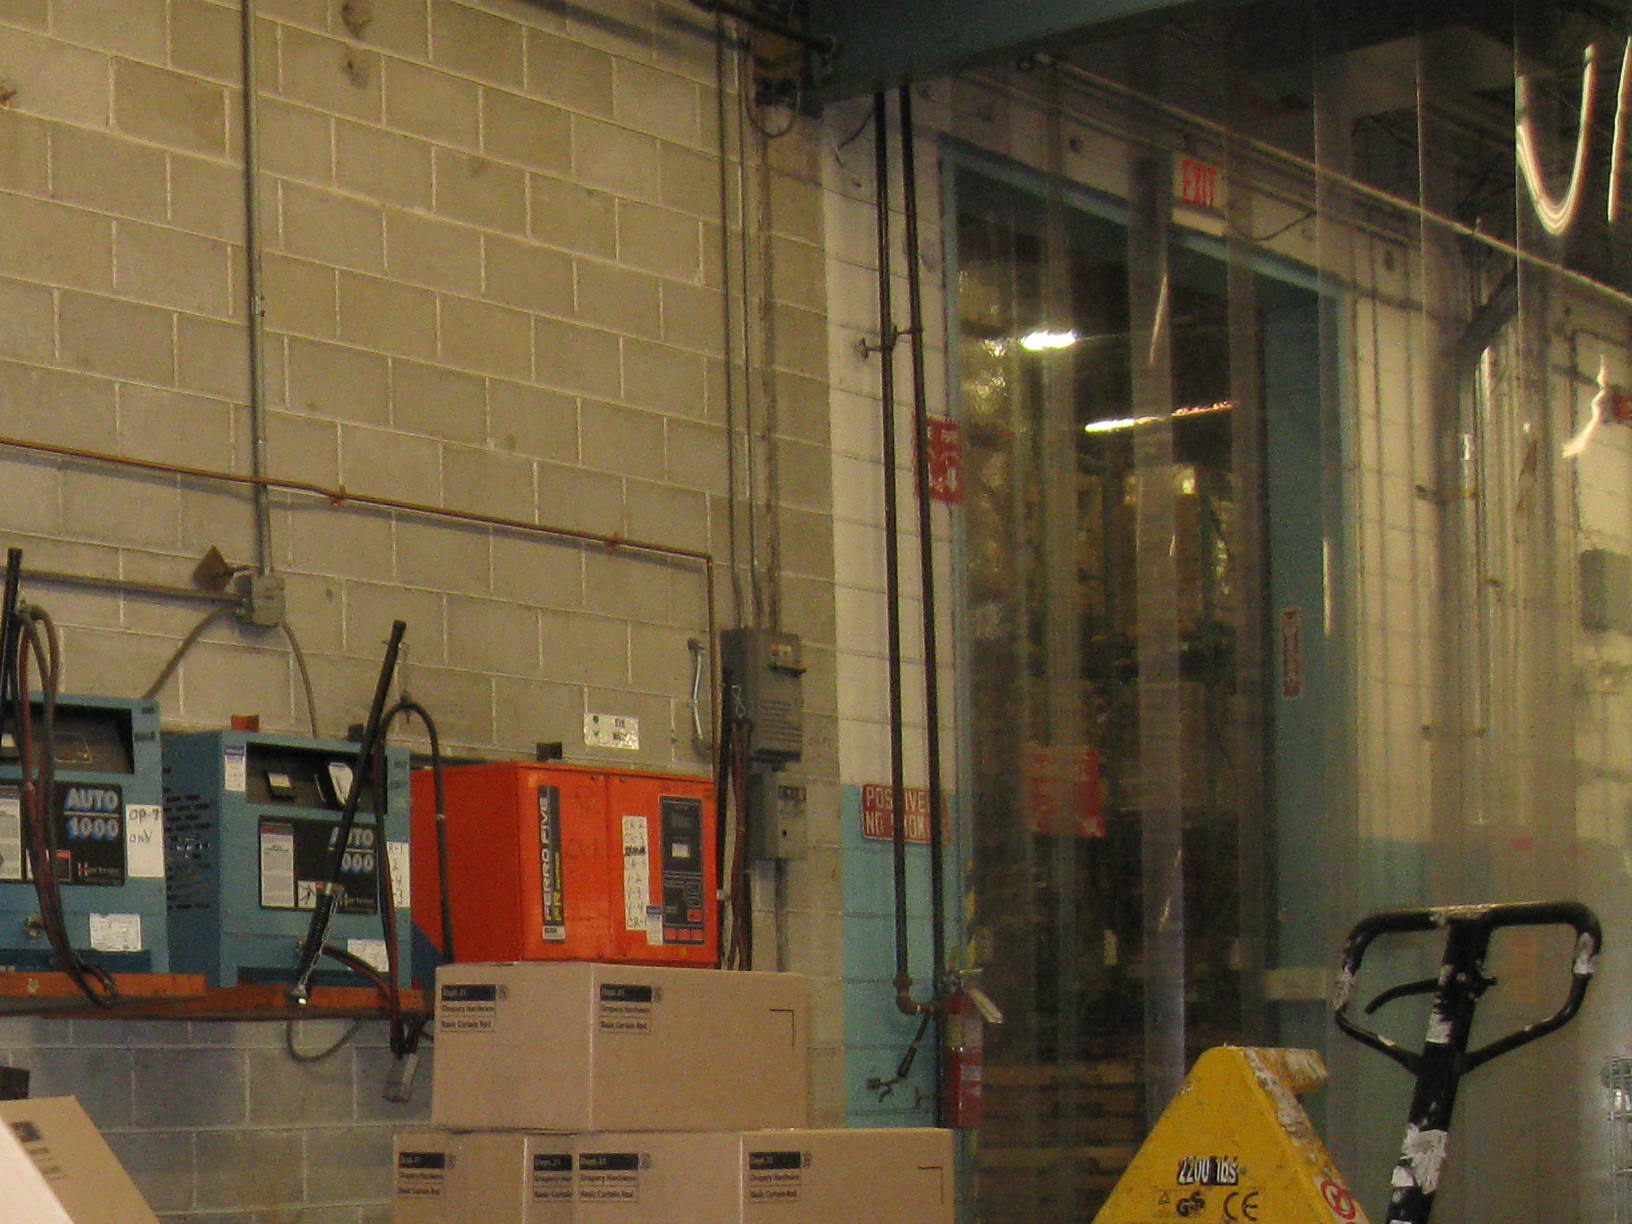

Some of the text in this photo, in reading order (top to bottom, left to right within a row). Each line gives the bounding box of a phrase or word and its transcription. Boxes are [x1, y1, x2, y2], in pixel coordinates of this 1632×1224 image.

[1183, 160, 1217, 208] EXIT
[65, 787, 118, 811] AUTO
[67, 816, 119, 840] 1000
[539, 796, 550, 844] FIVE
[541, 848, 554, 921] FERRO
[1223, 1191, 1259, 1222] CE
